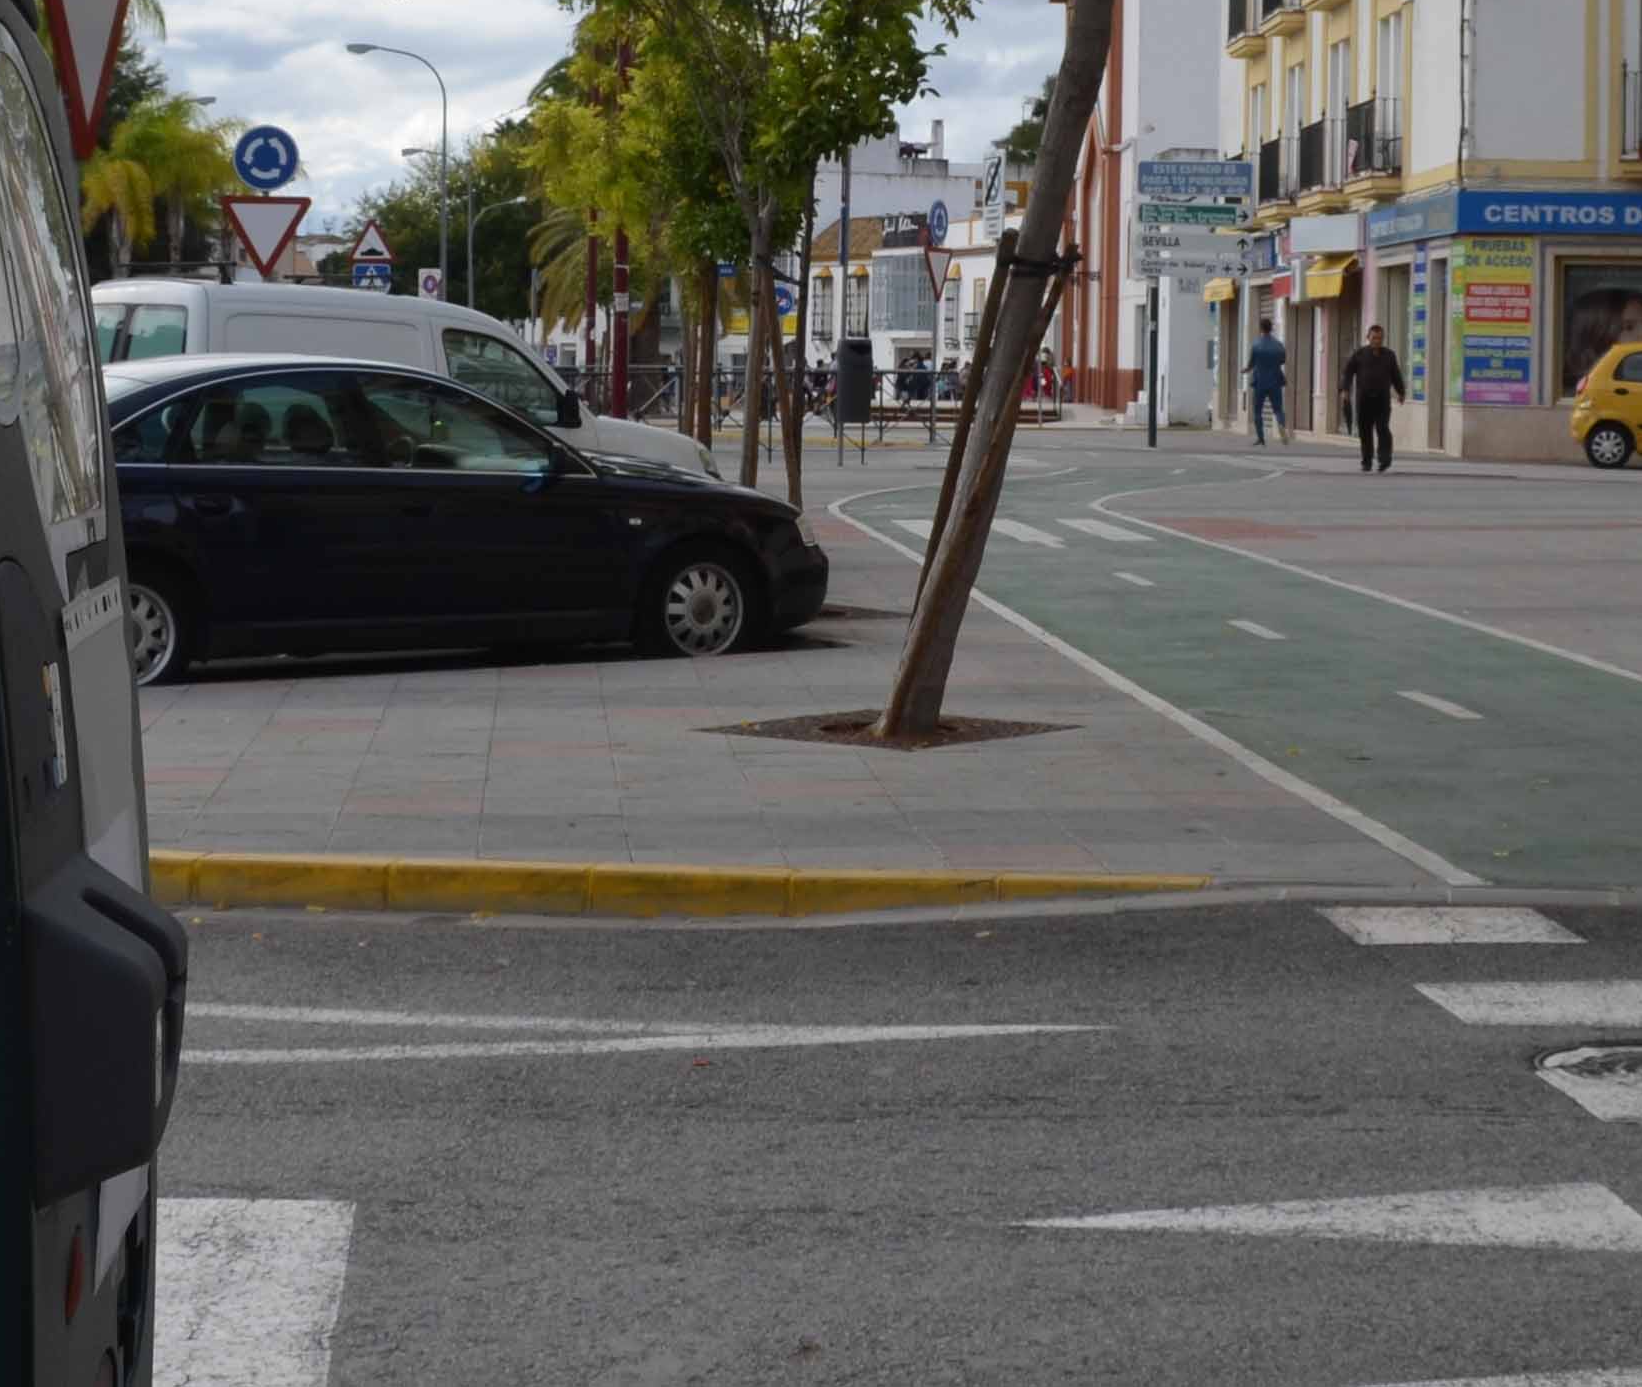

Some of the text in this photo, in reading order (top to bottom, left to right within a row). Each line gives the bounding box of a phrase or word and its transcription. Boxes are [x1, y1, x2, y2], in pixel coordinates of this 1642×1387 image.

[1484, 205, 1615, 225] CENTROS
[1141, 236, 1181, 248] SEVILLA
[1472, 240, 1525, 252] PRUEBAS
[1486, 255, 1533, 267] ACCESO
